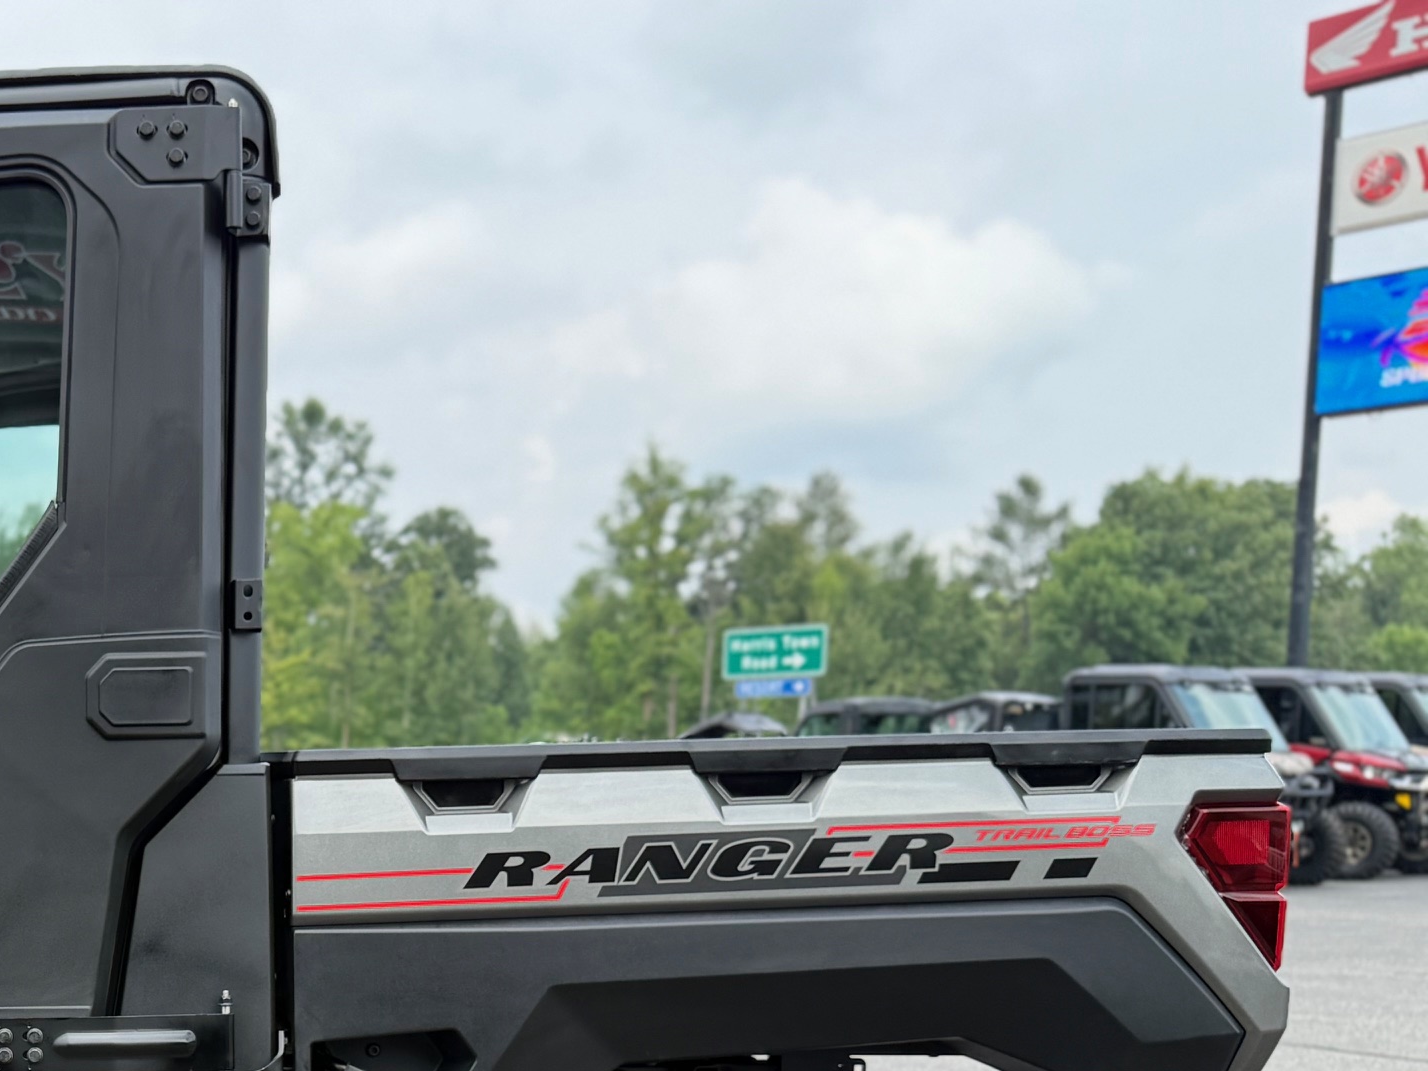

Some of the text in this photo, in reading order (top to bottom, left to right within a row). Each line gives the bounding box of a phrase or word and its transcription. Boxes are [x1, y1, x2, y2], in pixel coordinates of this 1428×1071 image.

[975, 823, 1157, 842] TRAIL BOSS
[462, 831, 956, 890] RANGER
